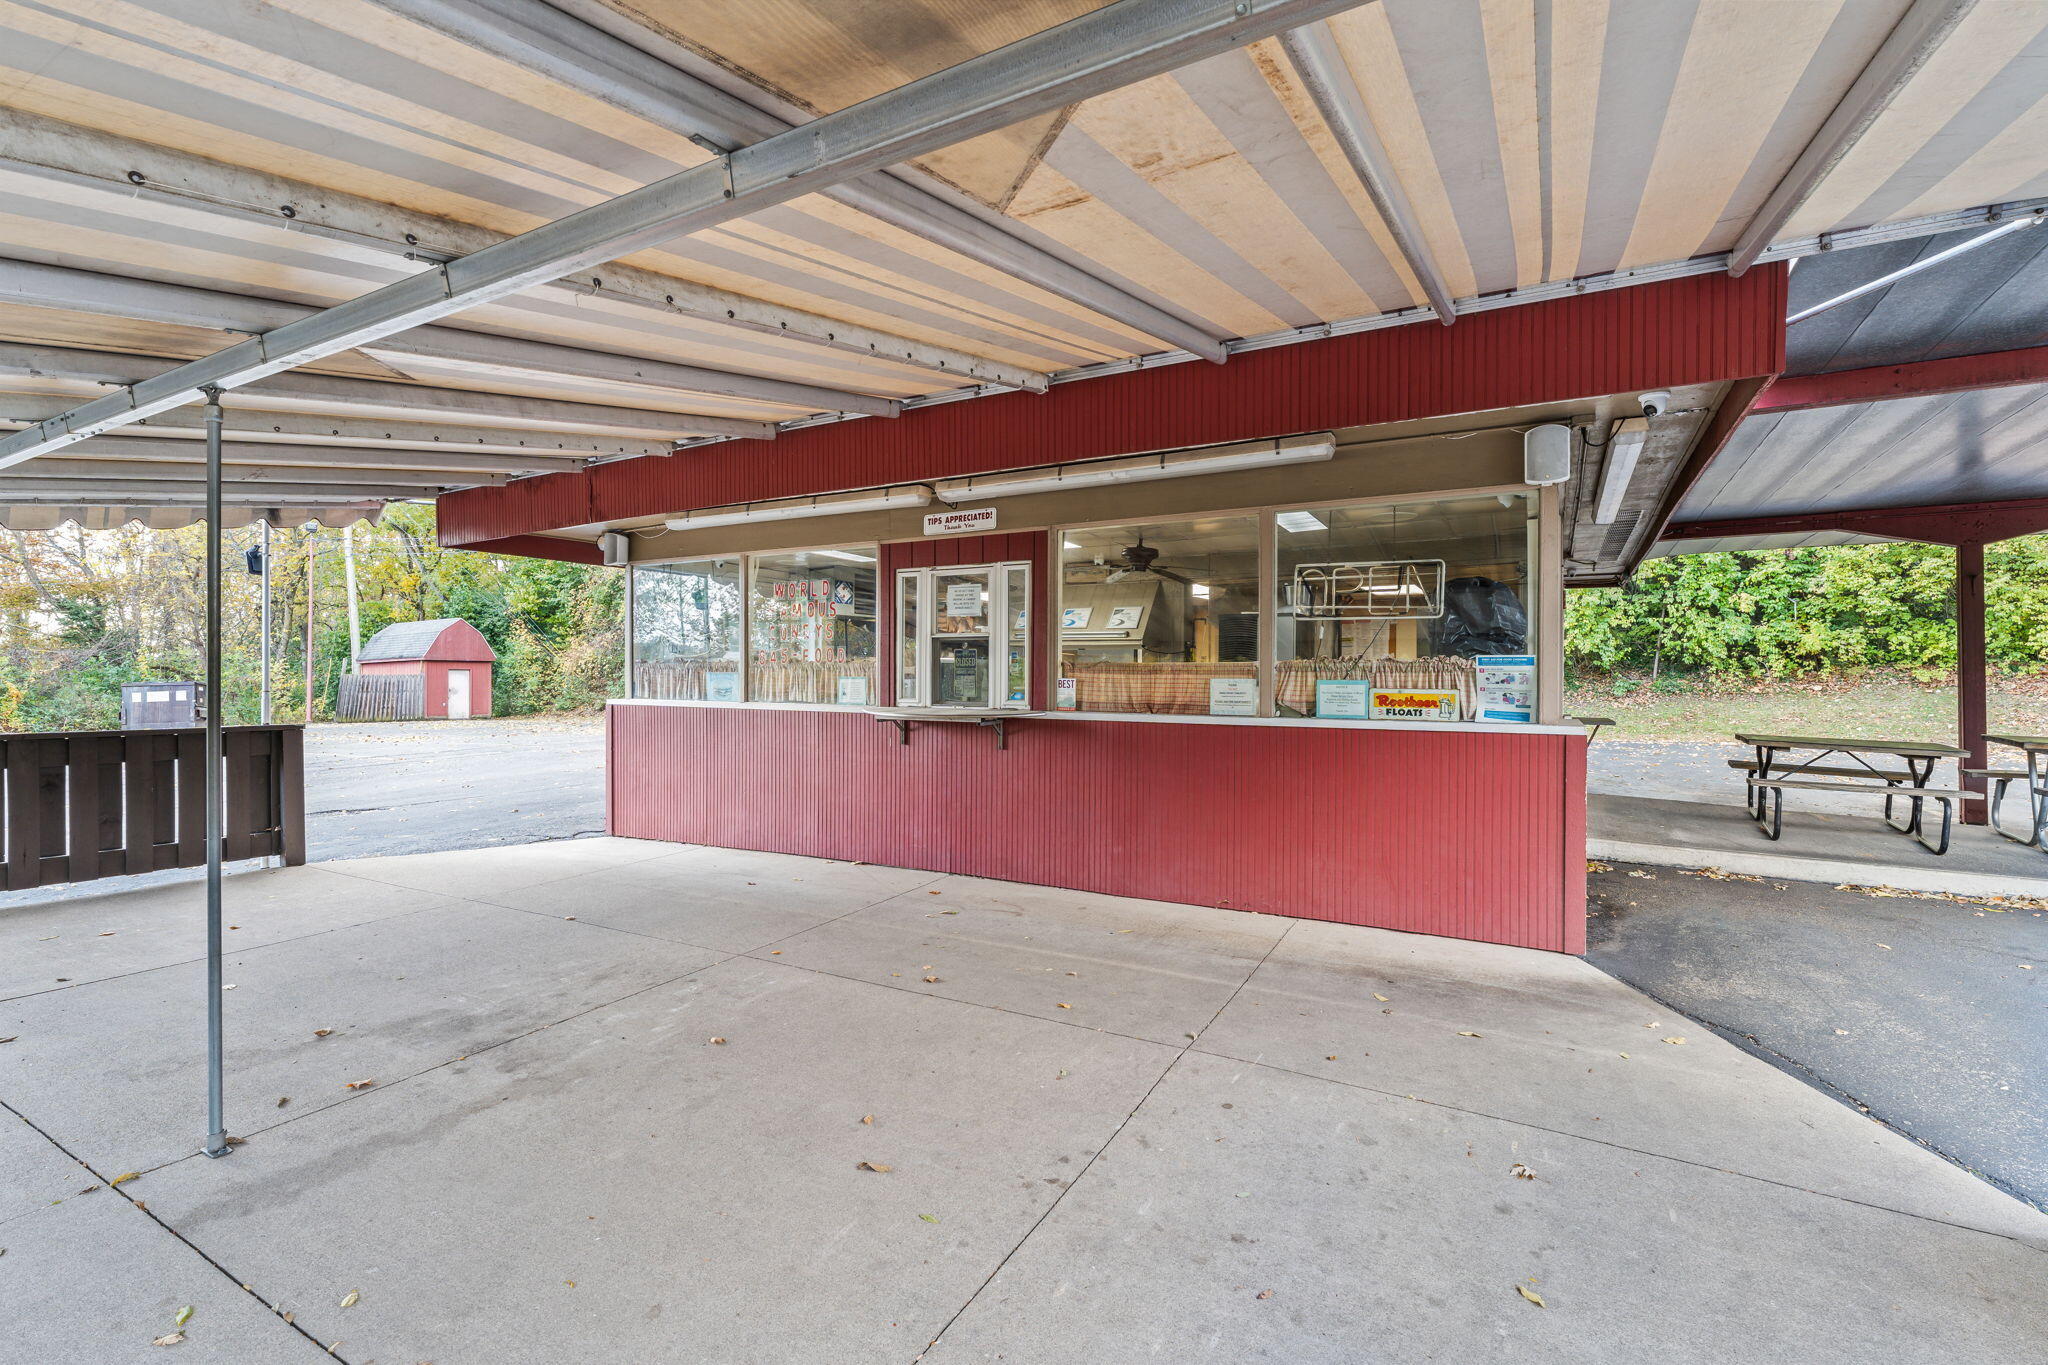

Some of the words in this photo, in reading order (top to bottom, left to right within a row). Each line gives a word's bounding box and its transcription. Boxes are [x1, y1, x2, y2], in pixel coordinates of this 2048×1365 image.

[927, 517, 942, 526] TIPS
[945, 511, 993, 524] APPRECIATED!
[774, 580, 830, 599] WORLD
[1298, 564, 1441, 616] OPEN
[1058, 679, 1075, 689] BEST
[1385, 708, 1423, 717] FLOATS
